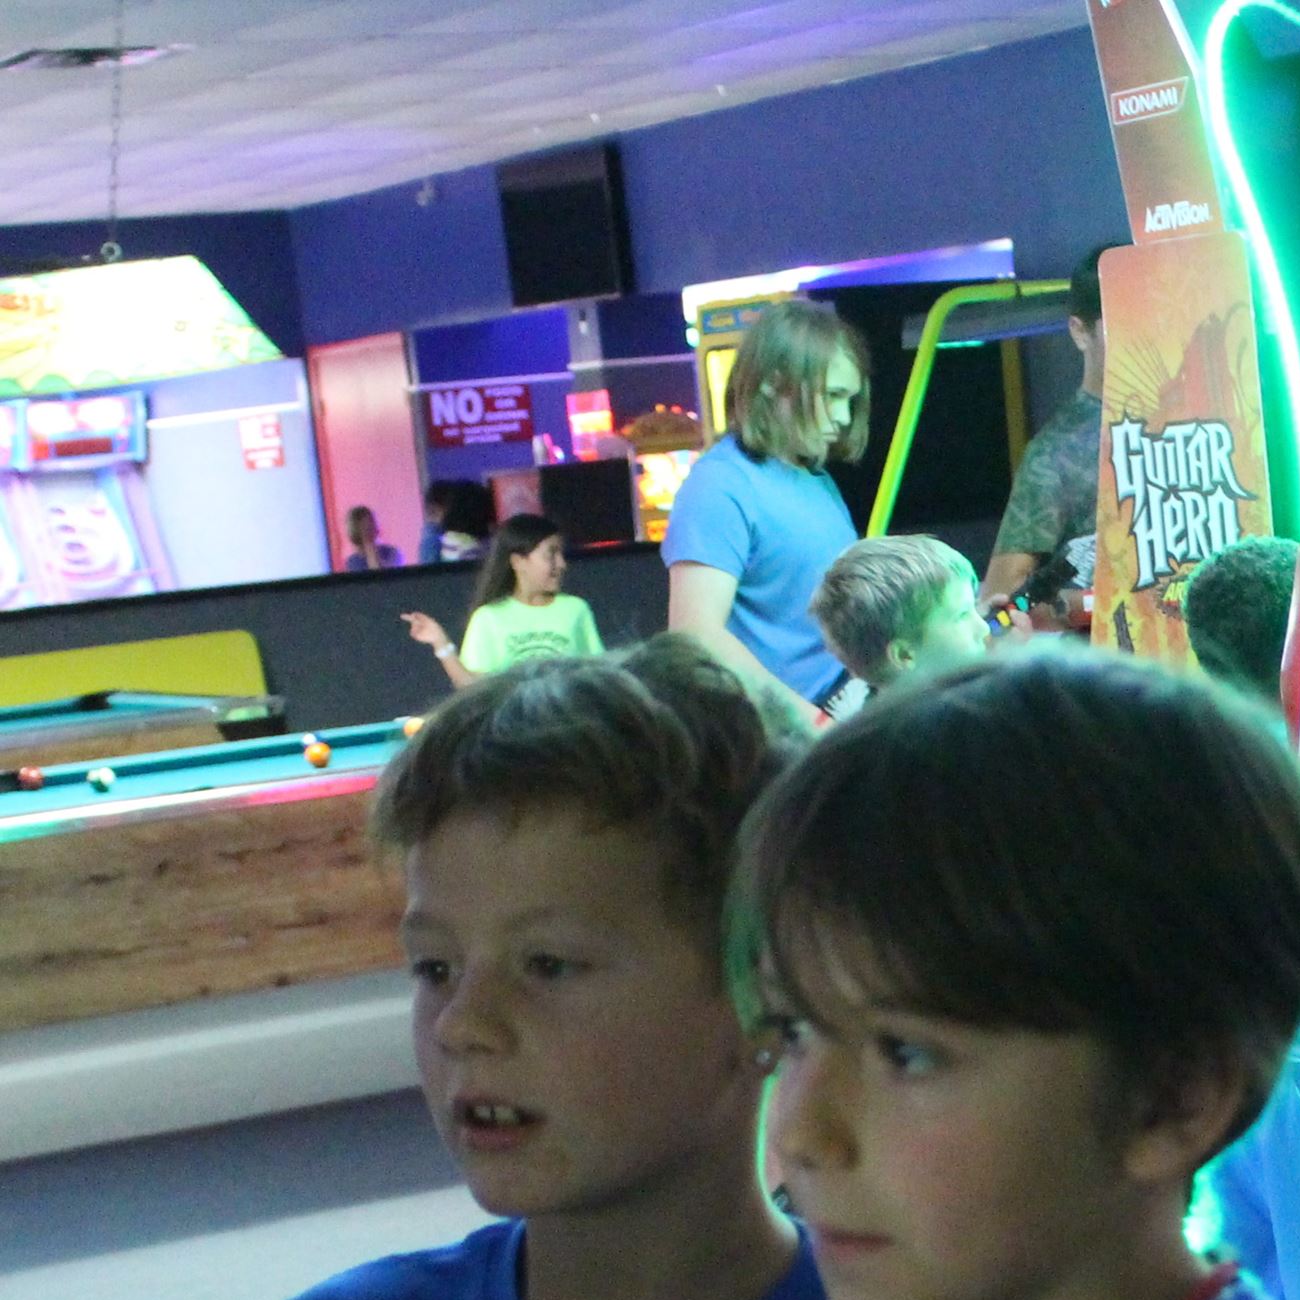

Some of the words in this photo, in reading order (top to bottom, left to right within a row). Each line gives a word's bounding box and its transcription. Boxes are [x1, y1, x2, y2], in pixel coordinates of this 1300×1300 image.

[1119, 87, 1179, 117] KONAMI
[1144, 200, 1211, 233] ACTIVISION
[430, 388, 483, 427] NO
[1110, 418, 1253, 514] GUITAR
[1131, 484, 1240, 589] HERO
